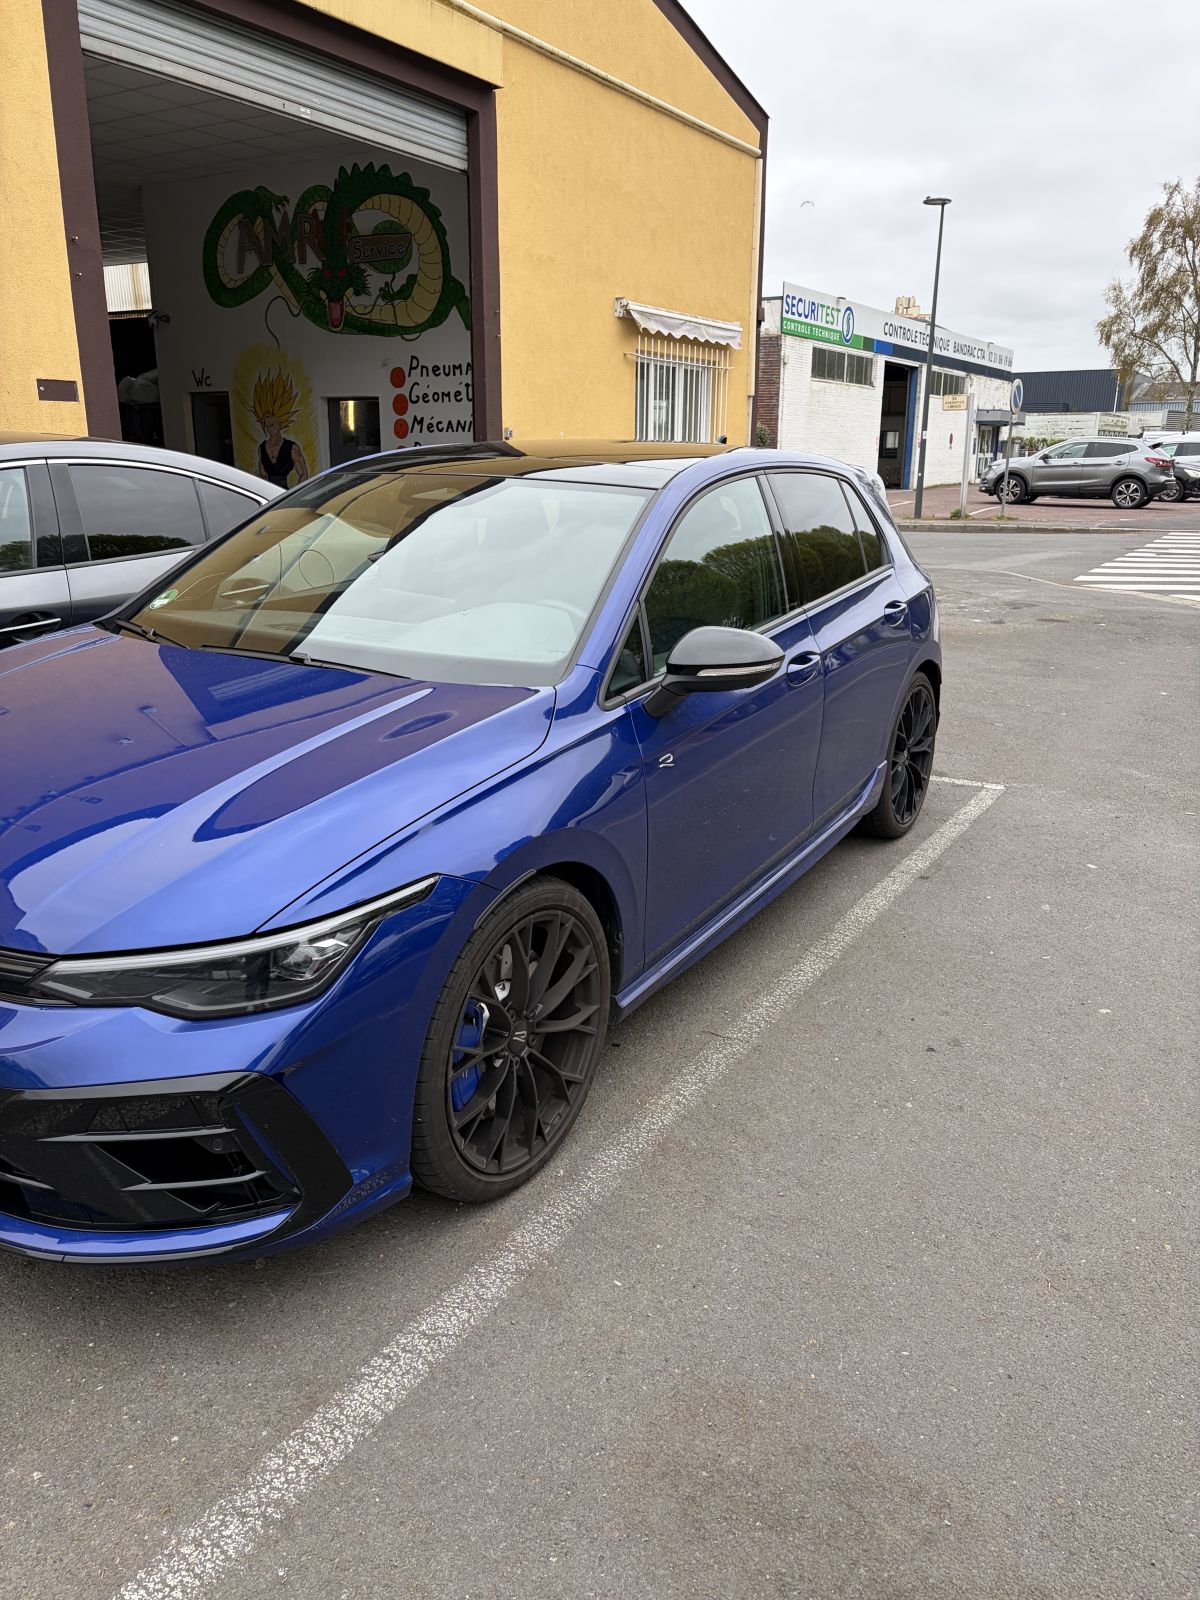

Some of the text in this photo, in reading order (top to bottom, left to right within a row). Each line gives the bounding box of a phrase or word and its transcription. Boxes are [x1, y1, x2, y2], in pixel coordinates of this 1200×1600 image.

[353, 240, 406, 259] Service
[784, 294, 841, 327] SECURITEST
[784, 320, 840, 341] CONTROLE TECHNIQUE
[883, 321, 918, 344] CONTROLE
[919, 331, 950, 352] TECNIQUE
